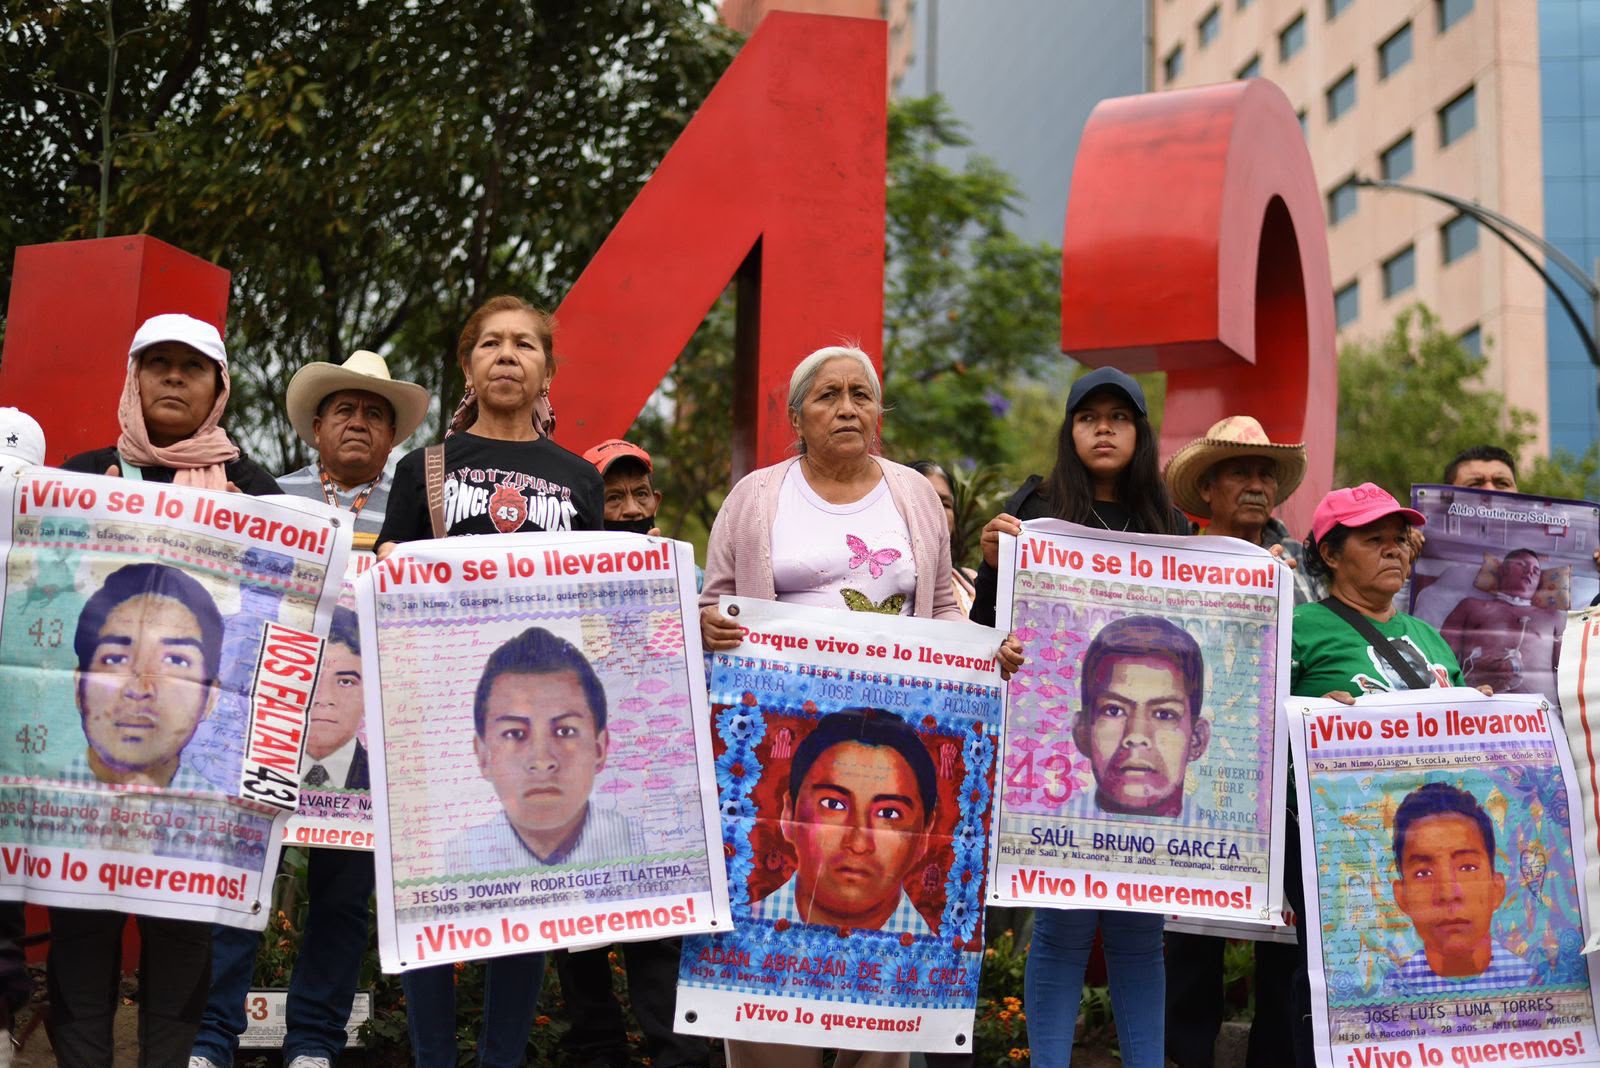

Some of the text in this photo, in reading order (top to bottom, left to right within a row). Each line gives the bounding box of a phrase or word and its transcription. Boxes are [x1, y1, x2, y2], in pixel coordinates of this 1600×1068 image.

[19, 480, 329, 555] ¡Vivo se lo llevaron!
[444, 478, 489, 532] ONCE
[496, 506, 519, 521] 43
[1448, 503, 1527, 522] Aldo Gutiérrez
[18, 527, 34, 538] Yo,
[40, 528, 55, 537] Jan
[59, 528, 90, 540] Nimmo,
[97, 530, 140, 544] Glasgow,
[147, 535, 189, 551] Escocia,
[195, 543, 229, 560] quiero
[233, 553, 260, 568] saber
[1020, 537, 1275, 589] ¡Vivo se lo llevaron!
[380, 556, 452, 593] ¡Vivo
[463, 558, 498, 582] se
[507, 552, 535, 578] lo
[544, 543, 671, 577] llevaron!
[402, 601, 418, 610] Jan
[423, 600, 455, 610] Nimmo,
[460, 597, 504, 609] Glasgow,
[509, 591, 552, 603] Escocia,
[557, 591, 588, 602] quiero
[593, 589, 619, 599] saber
[1021, 579, 1224, 609] Yo, Jan Nimmo, Escocia, quiero saber
[28, 617, 64, 648] 43
[263, 624, 321, 682] NOS
[815, 637, 859, 656] vivo
[865, 644, 887, 658] se
[893, 645, 913, 661] lo
[918, 647, 997, 673] llevaron!
[717, 656, 732, 667] Yo,
[740, 659, 756, 668] Jan
[761, 661, 793, 674] Nimmo,
[800, 665, 843, 680] Glasgow,
[850, 671, 893, 686] Escocia,
[900, 678, 933, 689] quiero
[938, 682, 963, 692] saber
[732, 672, 787, 693] ERIKA
[818, 682, 854, 701] JOSE
[860, 687, 912, 708] ANGEL
[15, 723, 49, 754] 43
[251, 680, 308, 774] FALTAN
[1310, 709, 1547, 749] ¡Vivo se lo llevaron!
[1007, 750, 1073, 803] 43
[1218, 766, 1264, 781] QUERIDO
[1315, 761, 1328, 770] Yo,
[1333, 760, 1347, 768] Jan
[1416, 756, 1450, 765] Escocia,
[1455, 755, 1481, 764] quiero
[1485, 752, 1508, 761] saber
[1512, 751, 1533, 760] dónde
[243, 766, 299, 812] 43!
[299, 794, 350, 810] LVAREZ
[1211, 780, 1244, 794] TIGRE
[0, 800, 26, 814] osé
[31, 800, 100, 821] Eduardo
[111, 806, 186, 829] Bartolo
[296, 826, 375, 848] quere
[1030, 825, 1241, 860] SAÚL BRUNO GARCÍA
[0, 847, 248, 901] Vivo lo queremos!
[1001, 846, 1020, 856] Hijo
[1025, 848, 1035, 856] de
[1040, 848, 1058, 857] Saúl
[1063, 852, 1068, 860] y
[1072, 851, 1110, 862] Nicanora
[1124, 855, 1133, 864] 18
[1137, 857, 1156, 866] años
[1170, 859, 1216, 871] Tecoanapa,
[412, 863, 692, 905] JESÚS JOVANY RODRÍGUEZ TLATEMPA
[1011, 868, 1253, 909] ¡Vivo lo queremos!
[436, 904, 460, 915] Hijo
[464, 903, 476, 912] de
[481, 900, 509, 911] María
[416, 898, 697, 961] ¡Vivo lo queremos!
[690, 966, 715, 978] Hijo
[721, 969, 732, 978] de
[782, 977, 787, 987] y
[840, 981, 852, 990] 24
[890, 985, 901, 994] El
[698, 945, 968, 986] ADÁN ABRAJÁN DE LA CRUZ
[735, 1002, 922, 1033] ¡Vivo lo queremos!
[1338, 1032, 1361, 1042] Hijo
[1364, 1031, 1376, 1040] de
[1379, 1028, 1426, 1039] Macedonia
[1456, 1022, 1478, 1032] años
[1546, 1015, 1582, 1025] MORELOS
[1364, 998, 1554, 1024] JOSÉ LUÍS LUNA TORRES
[1348, 1031, 1586, 1068] ¡Vivo lo queremos!
